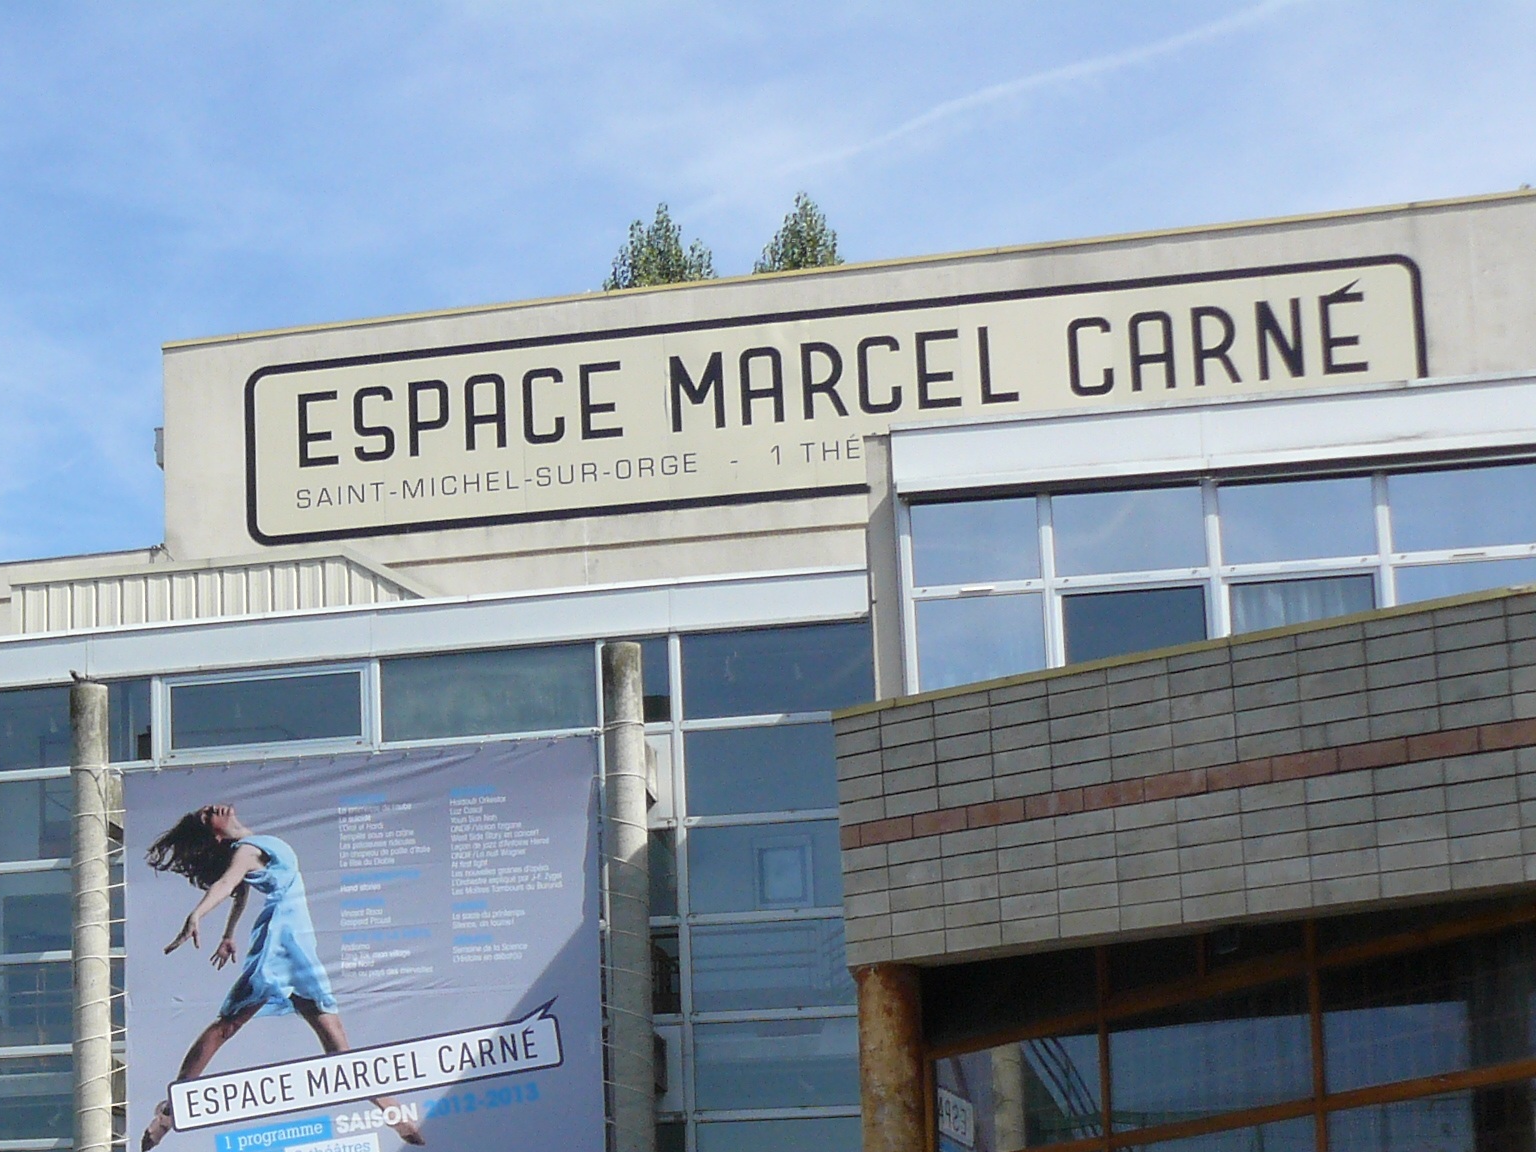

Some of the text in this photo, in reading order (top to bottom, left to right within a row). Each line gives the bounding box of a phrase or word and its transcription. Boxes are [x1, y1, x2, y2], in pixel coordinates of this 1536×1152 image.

[297, 277, 1369, 468] ESPACE MARCEL CARNÉ
[296, 450, 699, 510] SAINT-MICHEL-SUR-ORGE
[769, 444, 784, 466] 1
[185, 1024, 540, 1119] ESPACE MARCEL CARNÉ
[238, 1121, 324, 1150] programme
[335, 1081, 541, 1135] SAISON 2012-2013
